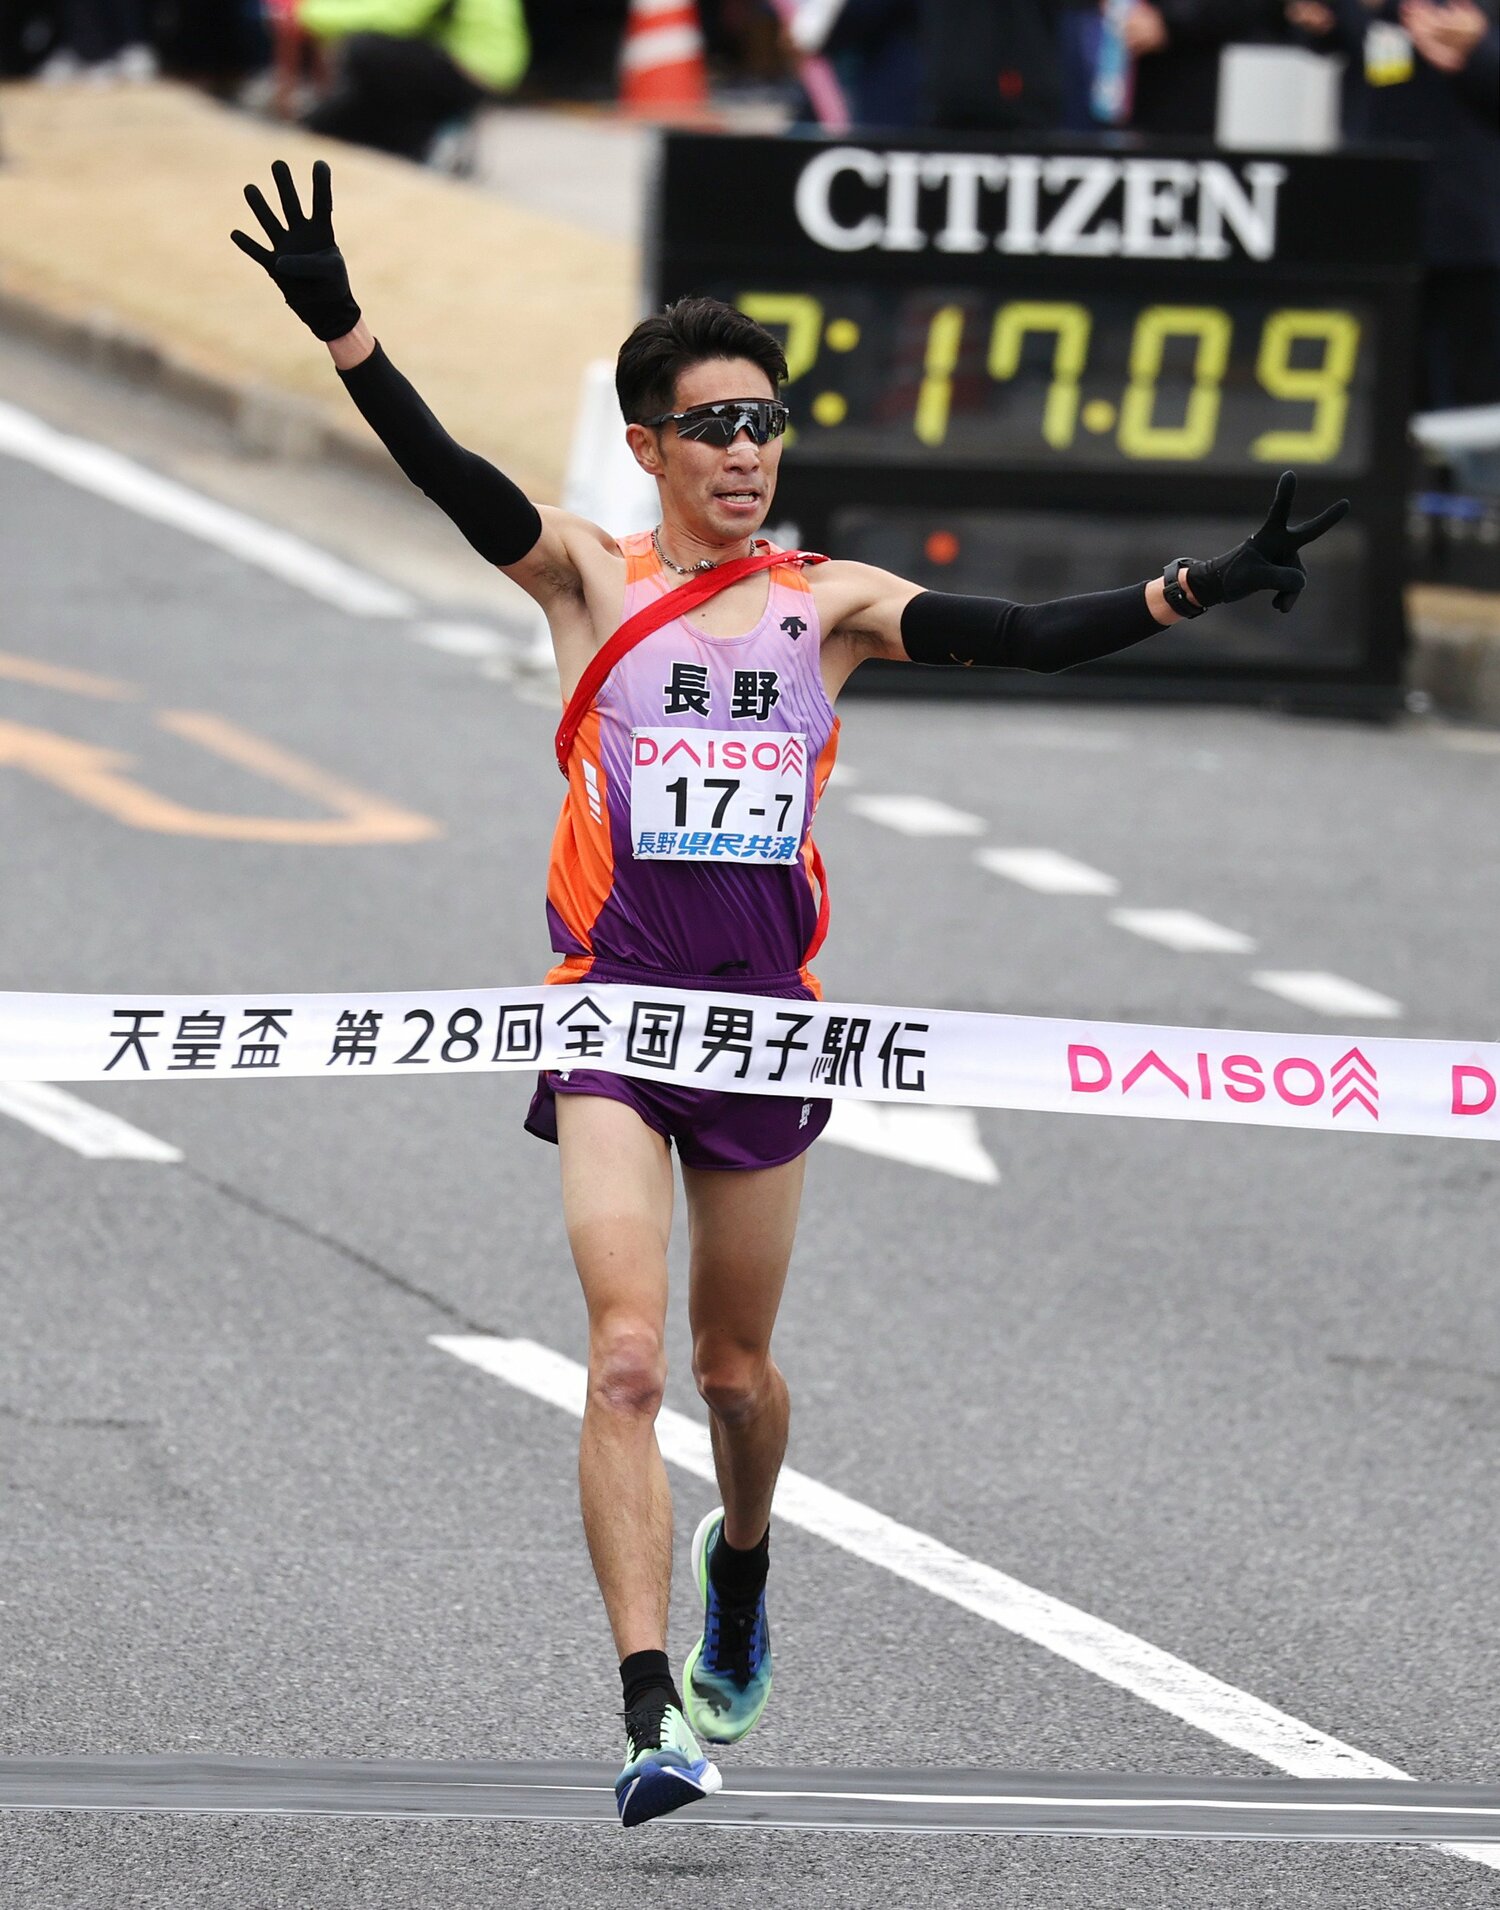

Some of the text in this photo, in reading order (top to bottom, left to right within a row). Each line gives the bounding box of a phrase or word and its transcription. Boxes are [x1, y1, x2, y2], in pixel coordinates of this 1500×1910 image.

[794, 147, 1288, 262] CITIZEN
[663, 661, 781, 721] 長野
[634, 737, 781, 771] DAISO
[1067, 1043, 1326, 1107] DAISO
